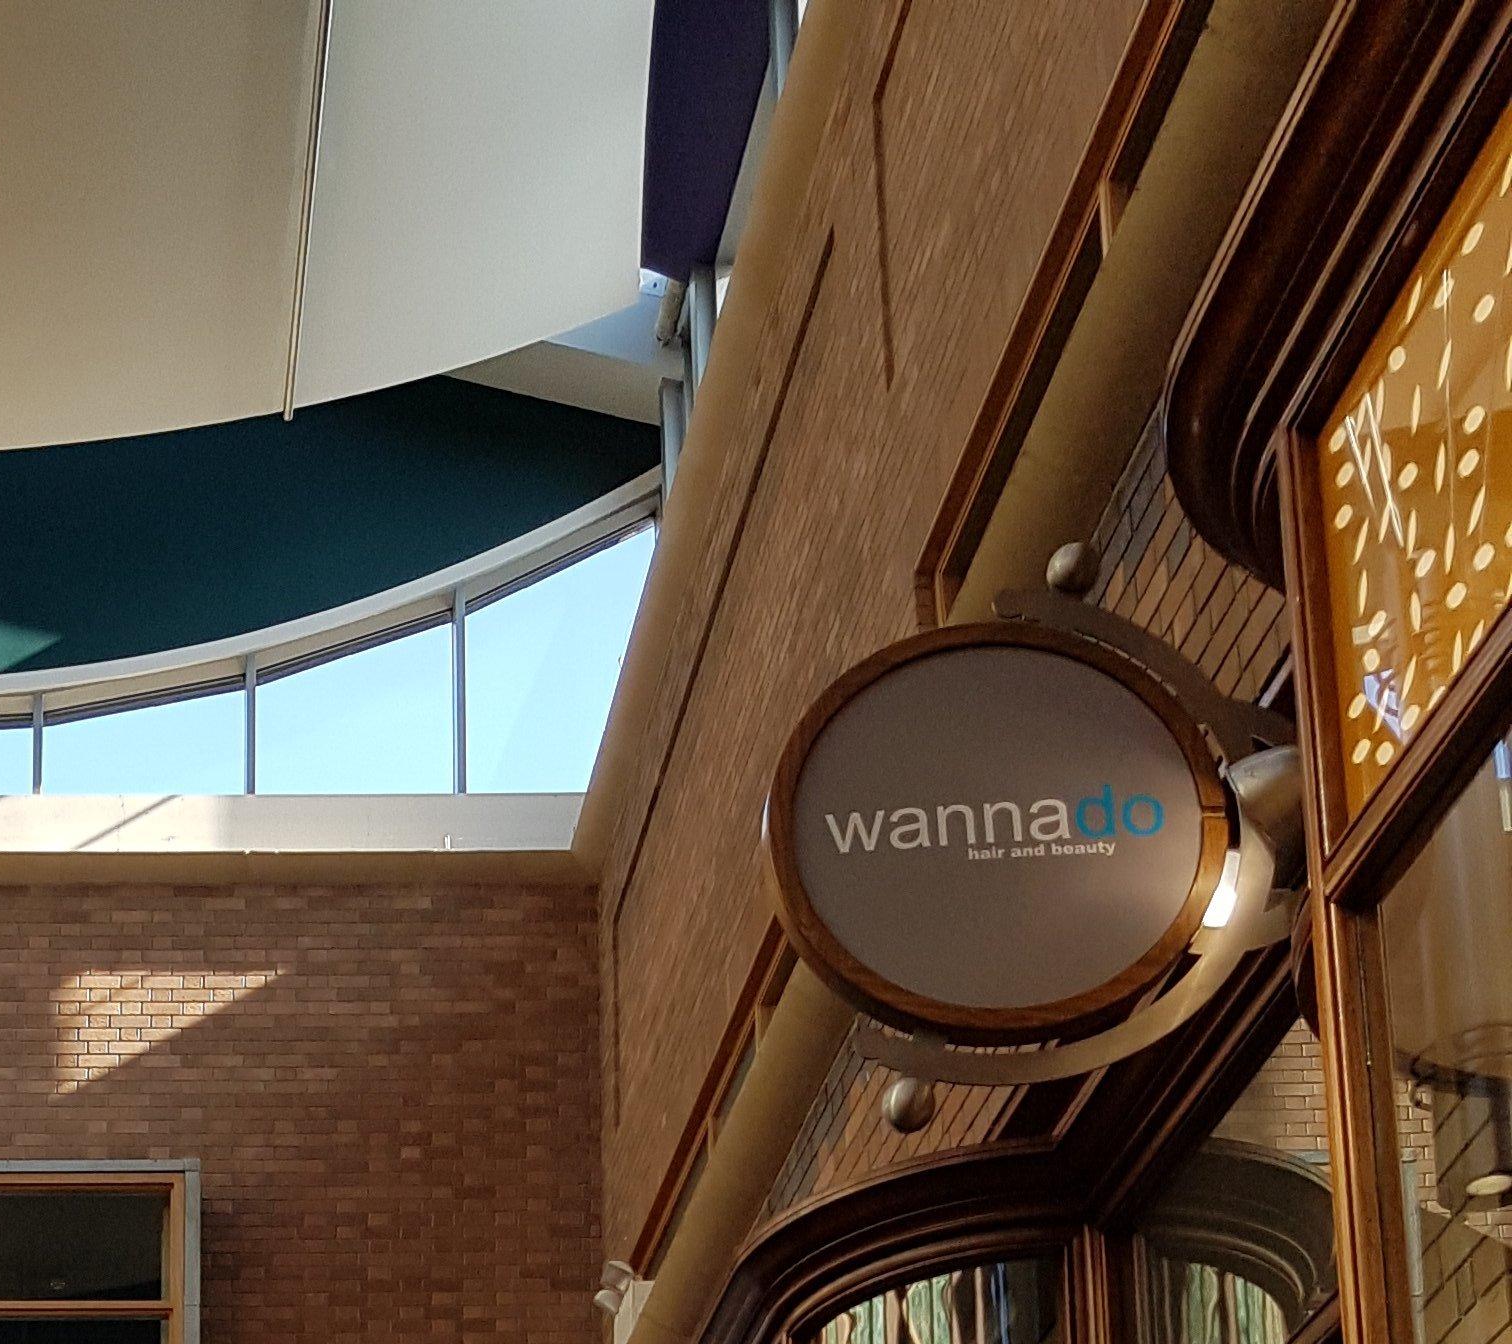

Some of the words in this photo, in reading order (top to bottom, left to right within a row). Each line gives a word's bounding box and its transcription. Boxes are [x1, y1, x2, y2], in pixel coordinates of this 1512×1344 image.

[824, 783, 1165, 853] wannado
[967, 845, 1006, 860] hair
[1010, 842, 1046, 857] and
[1050, 839, 1117, 857] beauty
